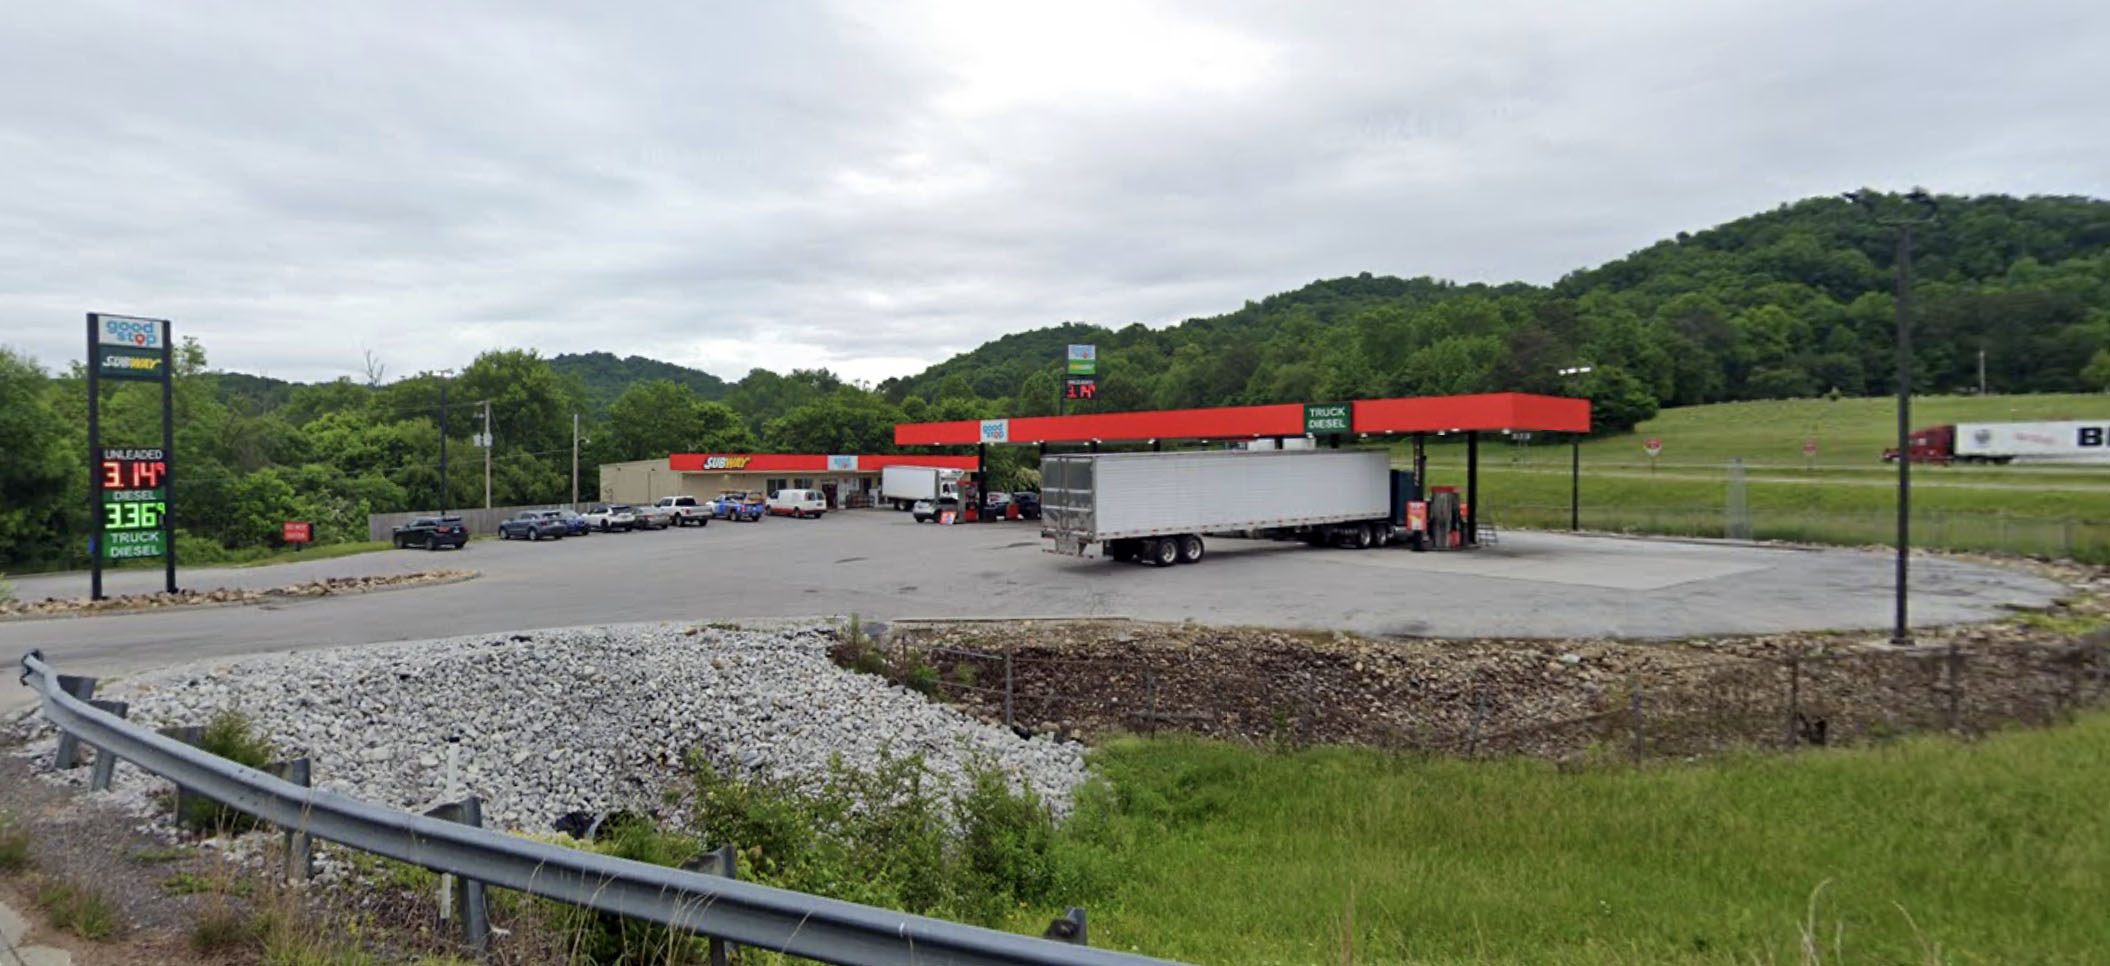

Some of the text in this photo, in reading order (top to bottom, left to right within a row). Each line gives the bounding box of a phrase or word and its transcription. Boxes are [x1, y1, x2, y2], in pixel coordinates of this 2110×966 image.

[106, 320, 154, 334] good
[118, 332, 155, 346] stop
[102, 356, 162, 369] SUBWAY
[1309, 407, 1345, 417] TRUCK
[1309, 419, 1346, 428] DIESEL
[104, 450, 162, 459] UNLEADED
[704, 457, 750, 469] SUBWAY
[113, 491, 156, 500] DIESEL
[111, 532, 158, 543] TRUCK
[110, 545, 159, 557] DIESEL
